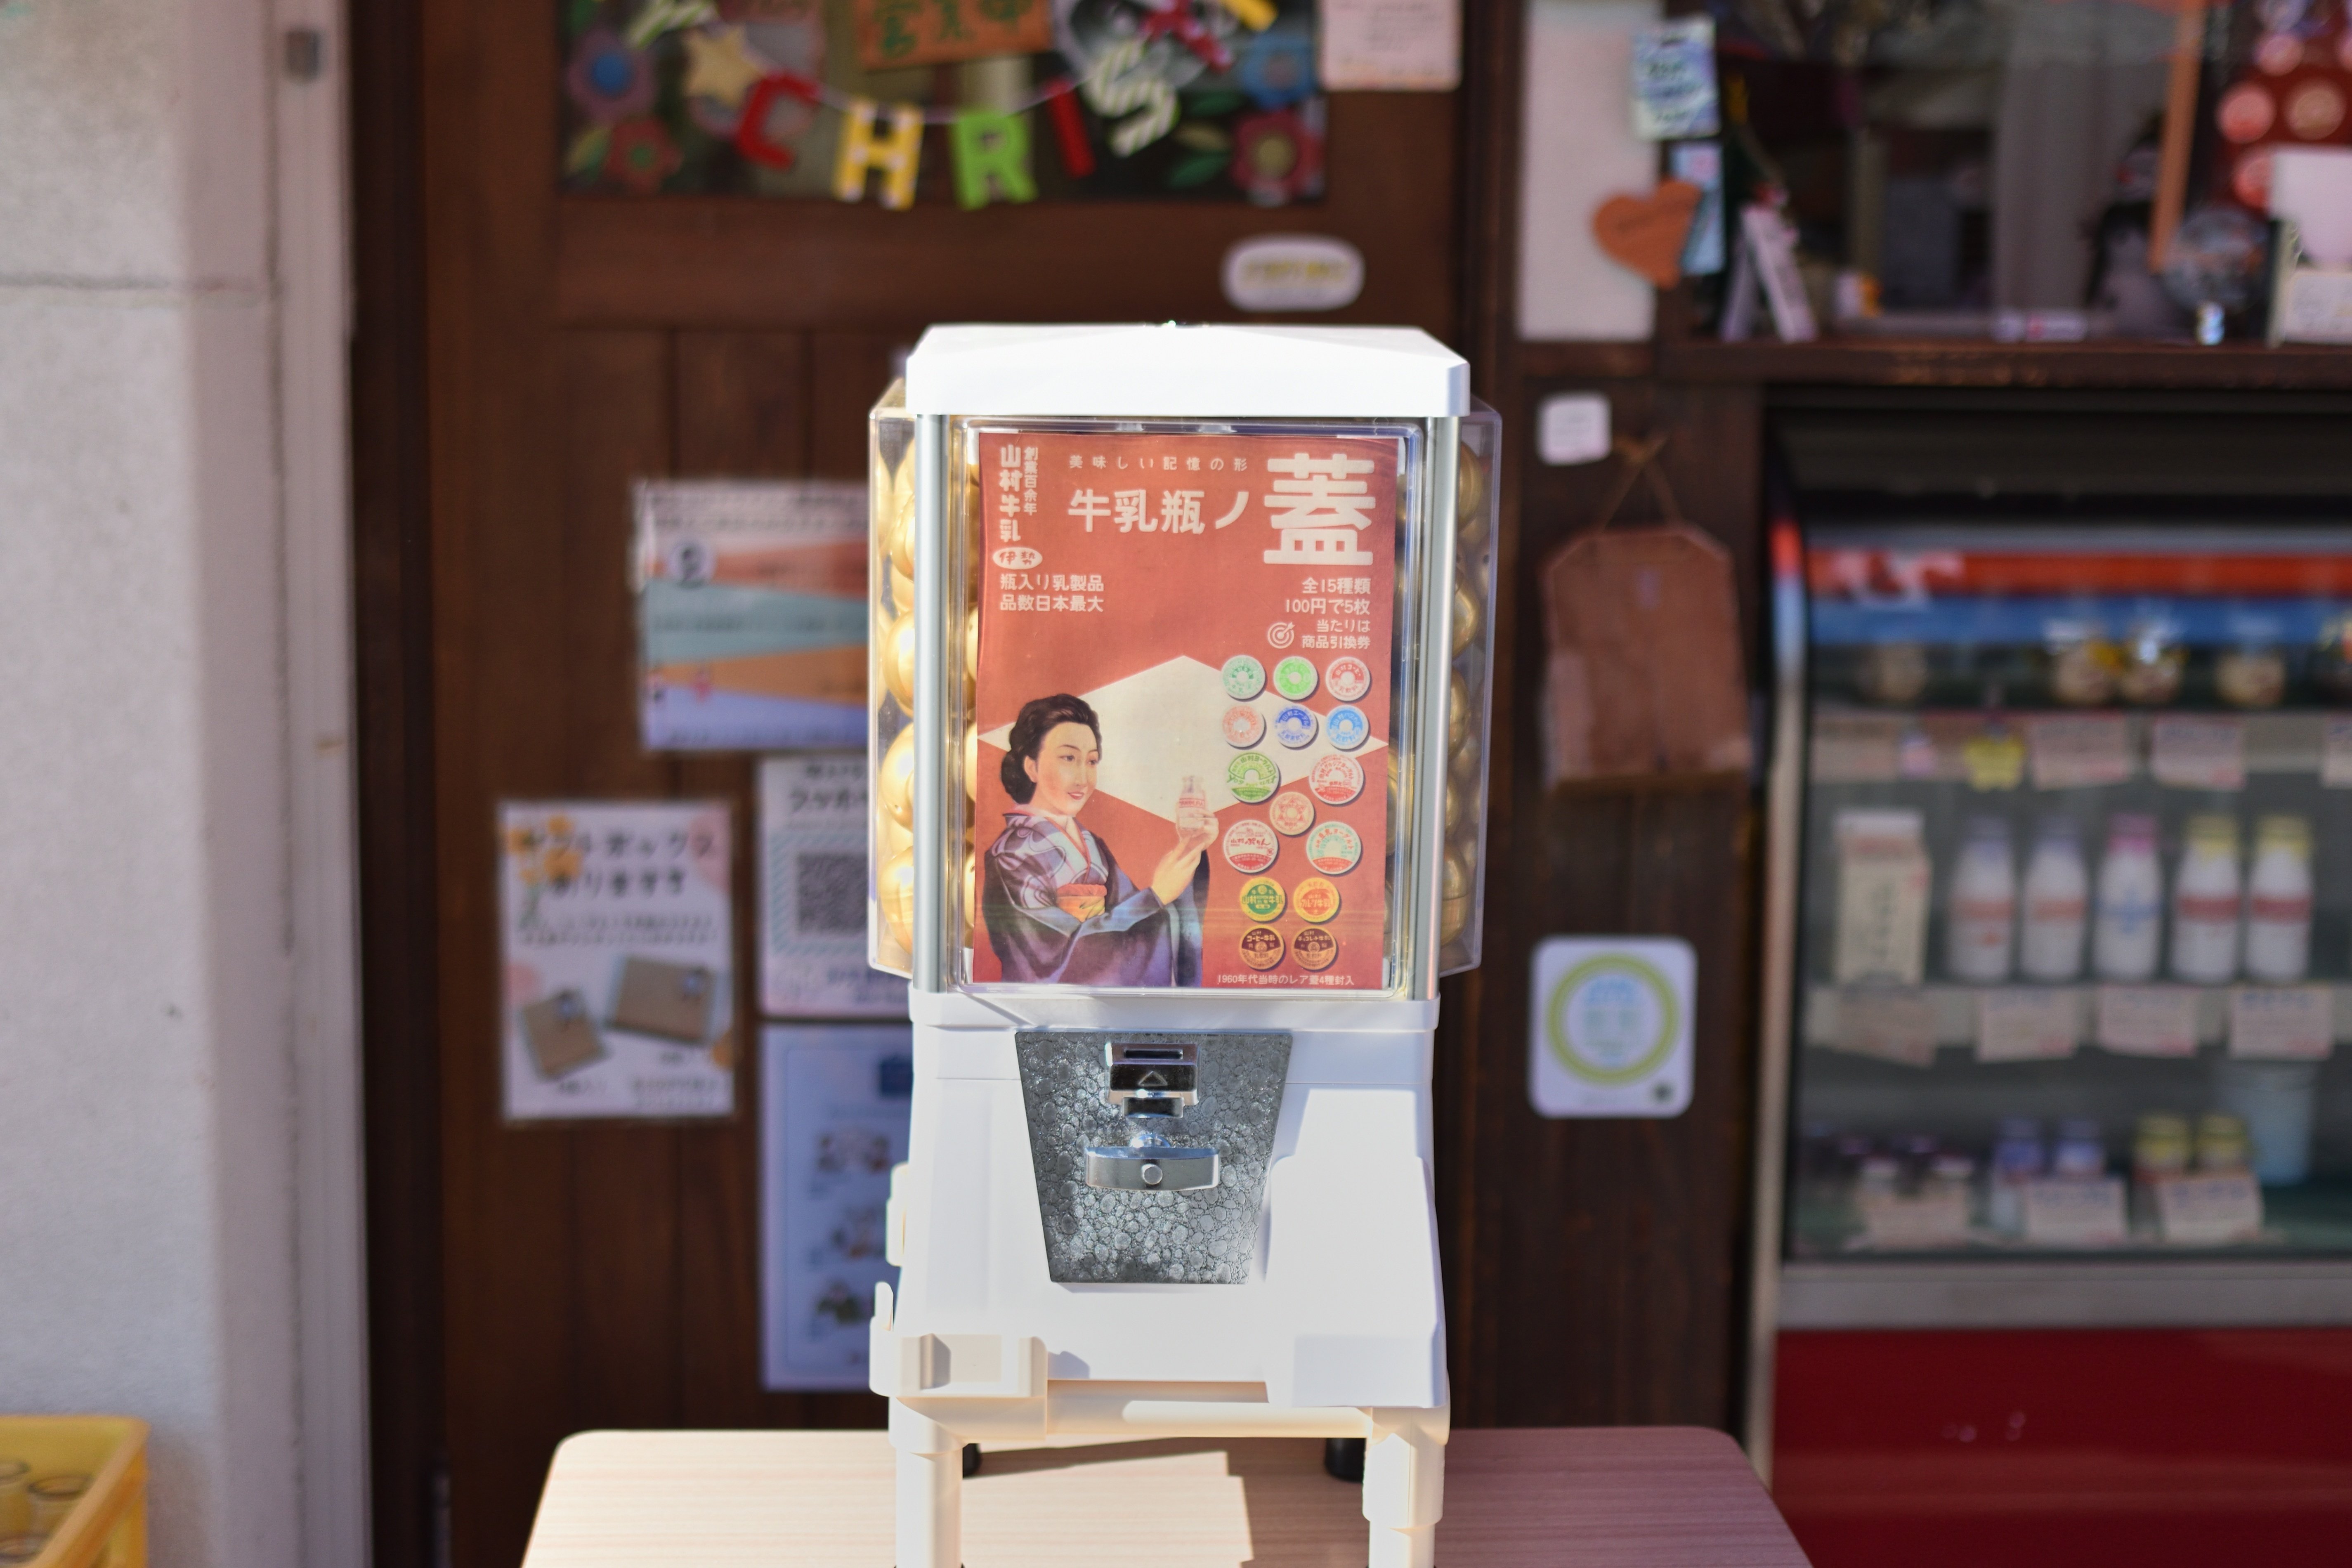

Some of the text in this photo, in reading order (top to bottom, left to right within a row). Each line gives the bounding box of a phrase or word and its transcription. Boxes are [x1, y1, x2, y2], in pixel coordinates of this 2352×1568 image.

[1069, 455, 1249, 472] 美味しい記憶の形
[1024, 446, 1039, 516] 創業百余年
[999, 444, 1023, 543] 山村牛乳
[1067, 489, 1249, 534] 牛乳瓶ノ
[1263, 453, 1376, 566] 蓋
[999, 551, 1036, 565] 伊勢
[1000, 574, 1104, 592] 瓶入り乳製品
[1302, 577, 1371, 594] 全15種類
[1000, 594, 1104, 612] 品数日本最大
[1285, 598, 1370, 615] 100円で5枚
[1317, 619, 1371, 633] 当たりは
[1302, 635, 1371, 649] 商品引換券
